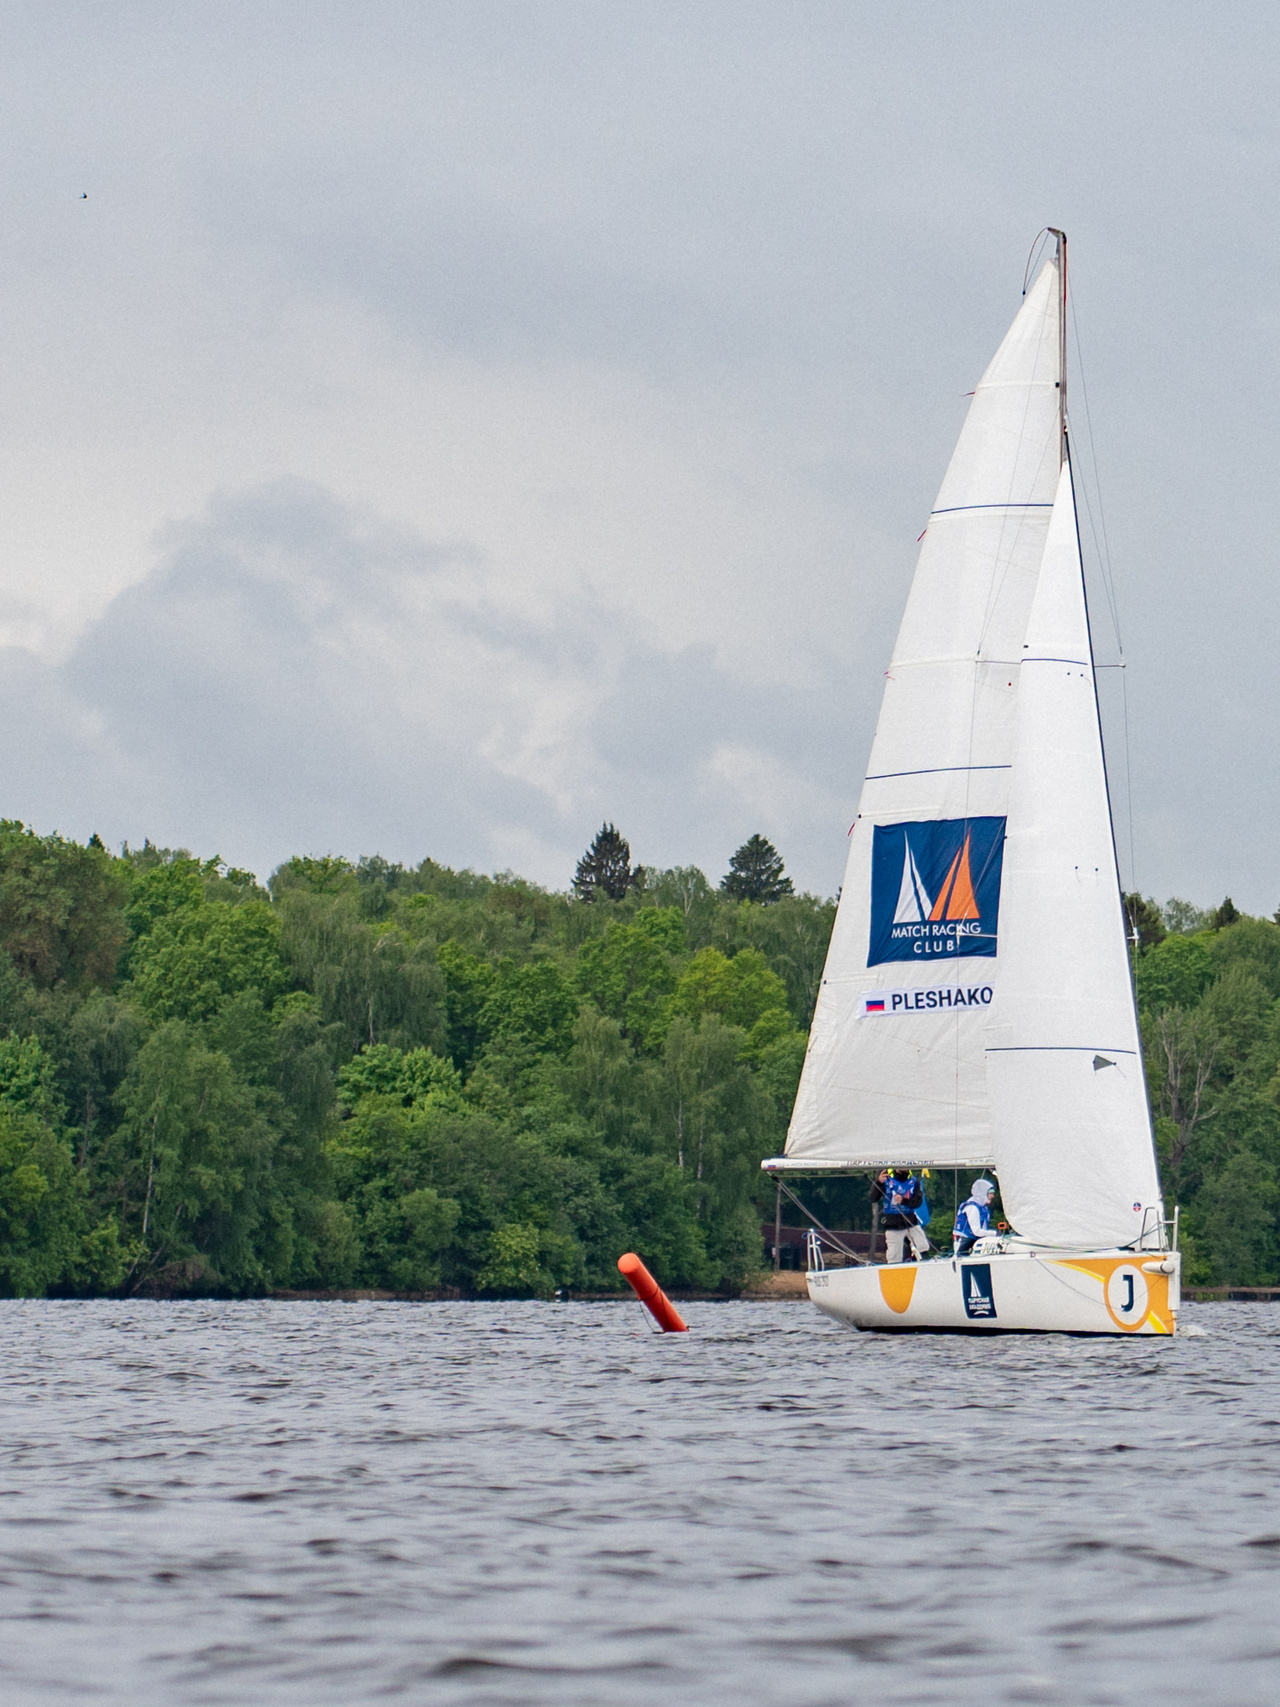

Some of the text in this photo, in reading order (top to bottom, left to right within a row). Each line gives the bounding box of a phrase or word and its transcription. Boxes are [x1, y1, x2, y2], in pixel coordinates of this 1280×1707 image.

[891, 922, 981, 939] MATCH RACING
[913, 940, 955, 954] CLUB
[891, 986, 993, 1010] PLESHAKO
[1120, 1274, 1134, 1313] J
